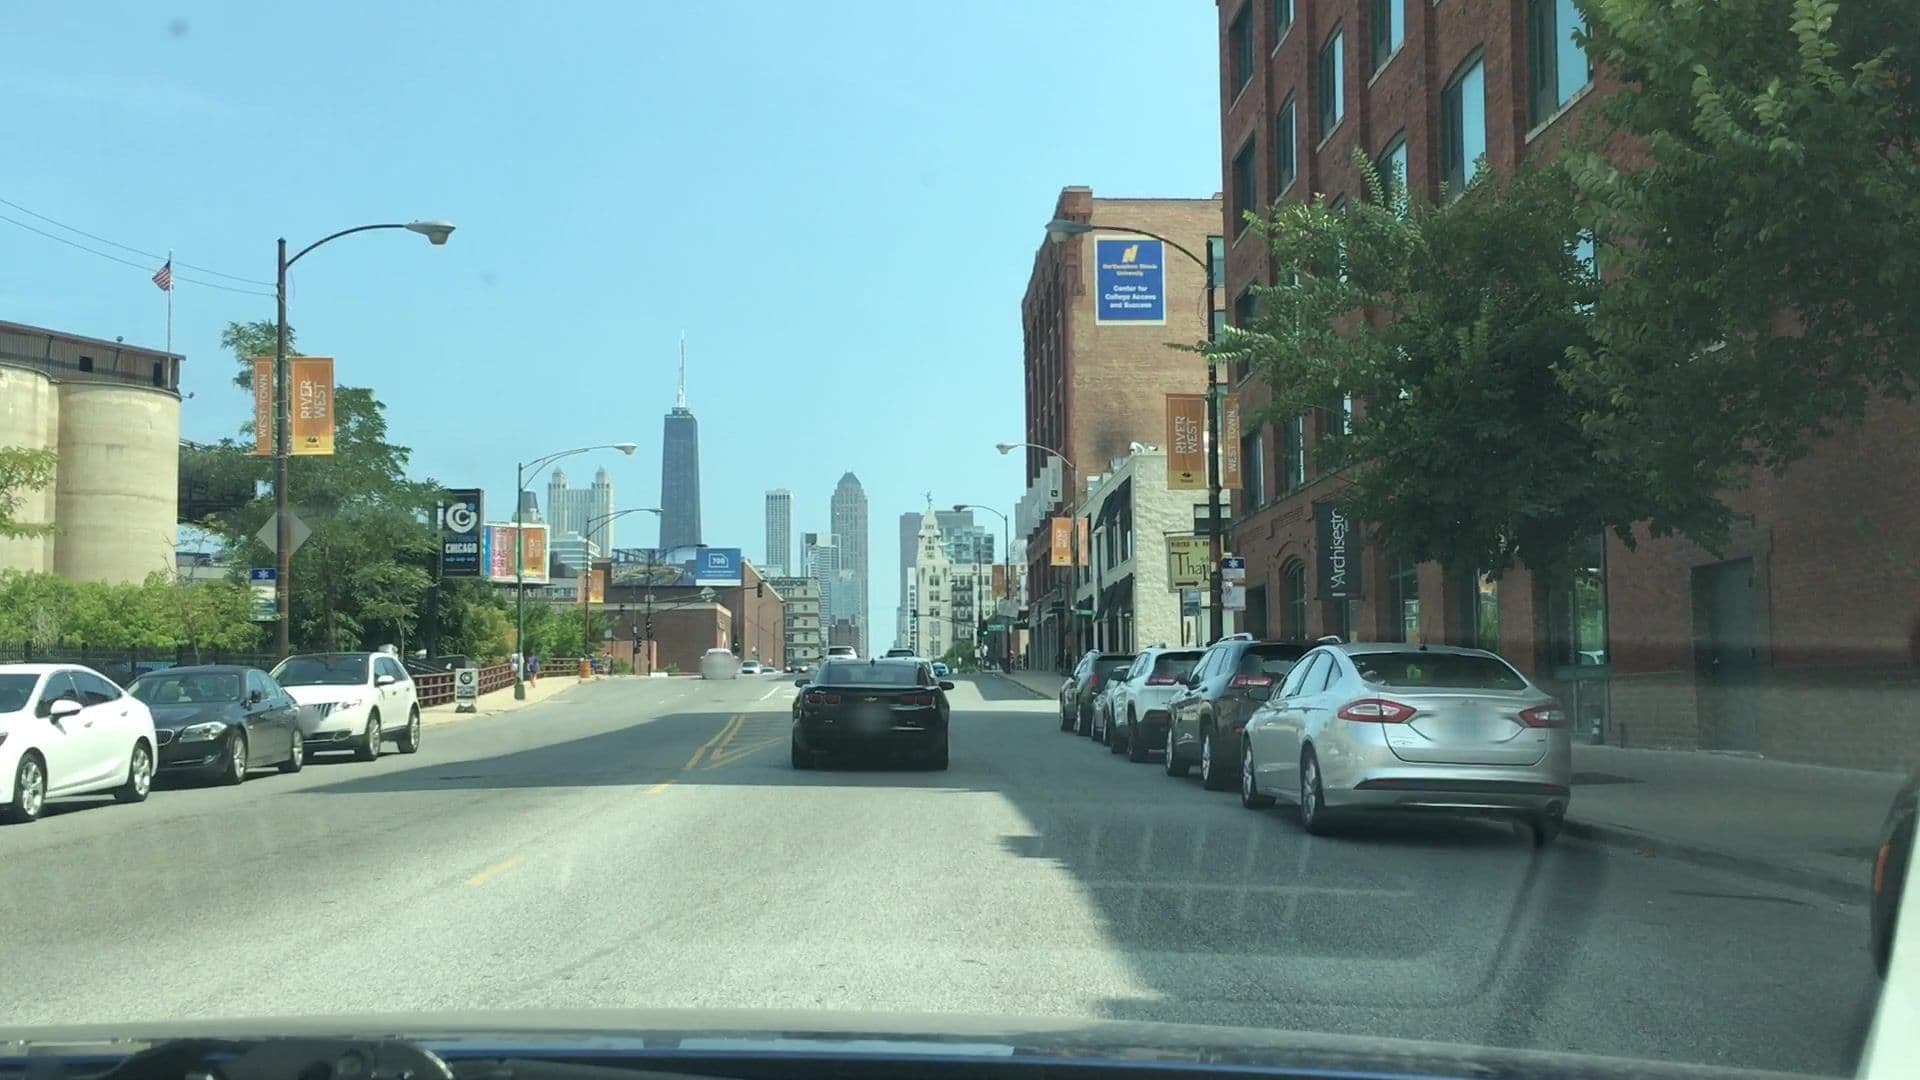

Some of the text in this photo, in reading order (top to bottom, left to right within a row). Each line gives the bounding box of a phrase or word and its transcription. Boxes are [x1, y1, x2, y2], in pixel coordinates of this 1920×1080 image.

[1112, 284, 1137, 292] Center
[300, 379, 313, 420] RIVER
[313, 383, 327, 420] WEST
[1175, 415, 1187, 455] RIVER
[1187, 417, 1199, 455] WEST
[1226, 410, 1238, 473] WEST TOWN
[445, 542, 478, 554] CHICAGO
